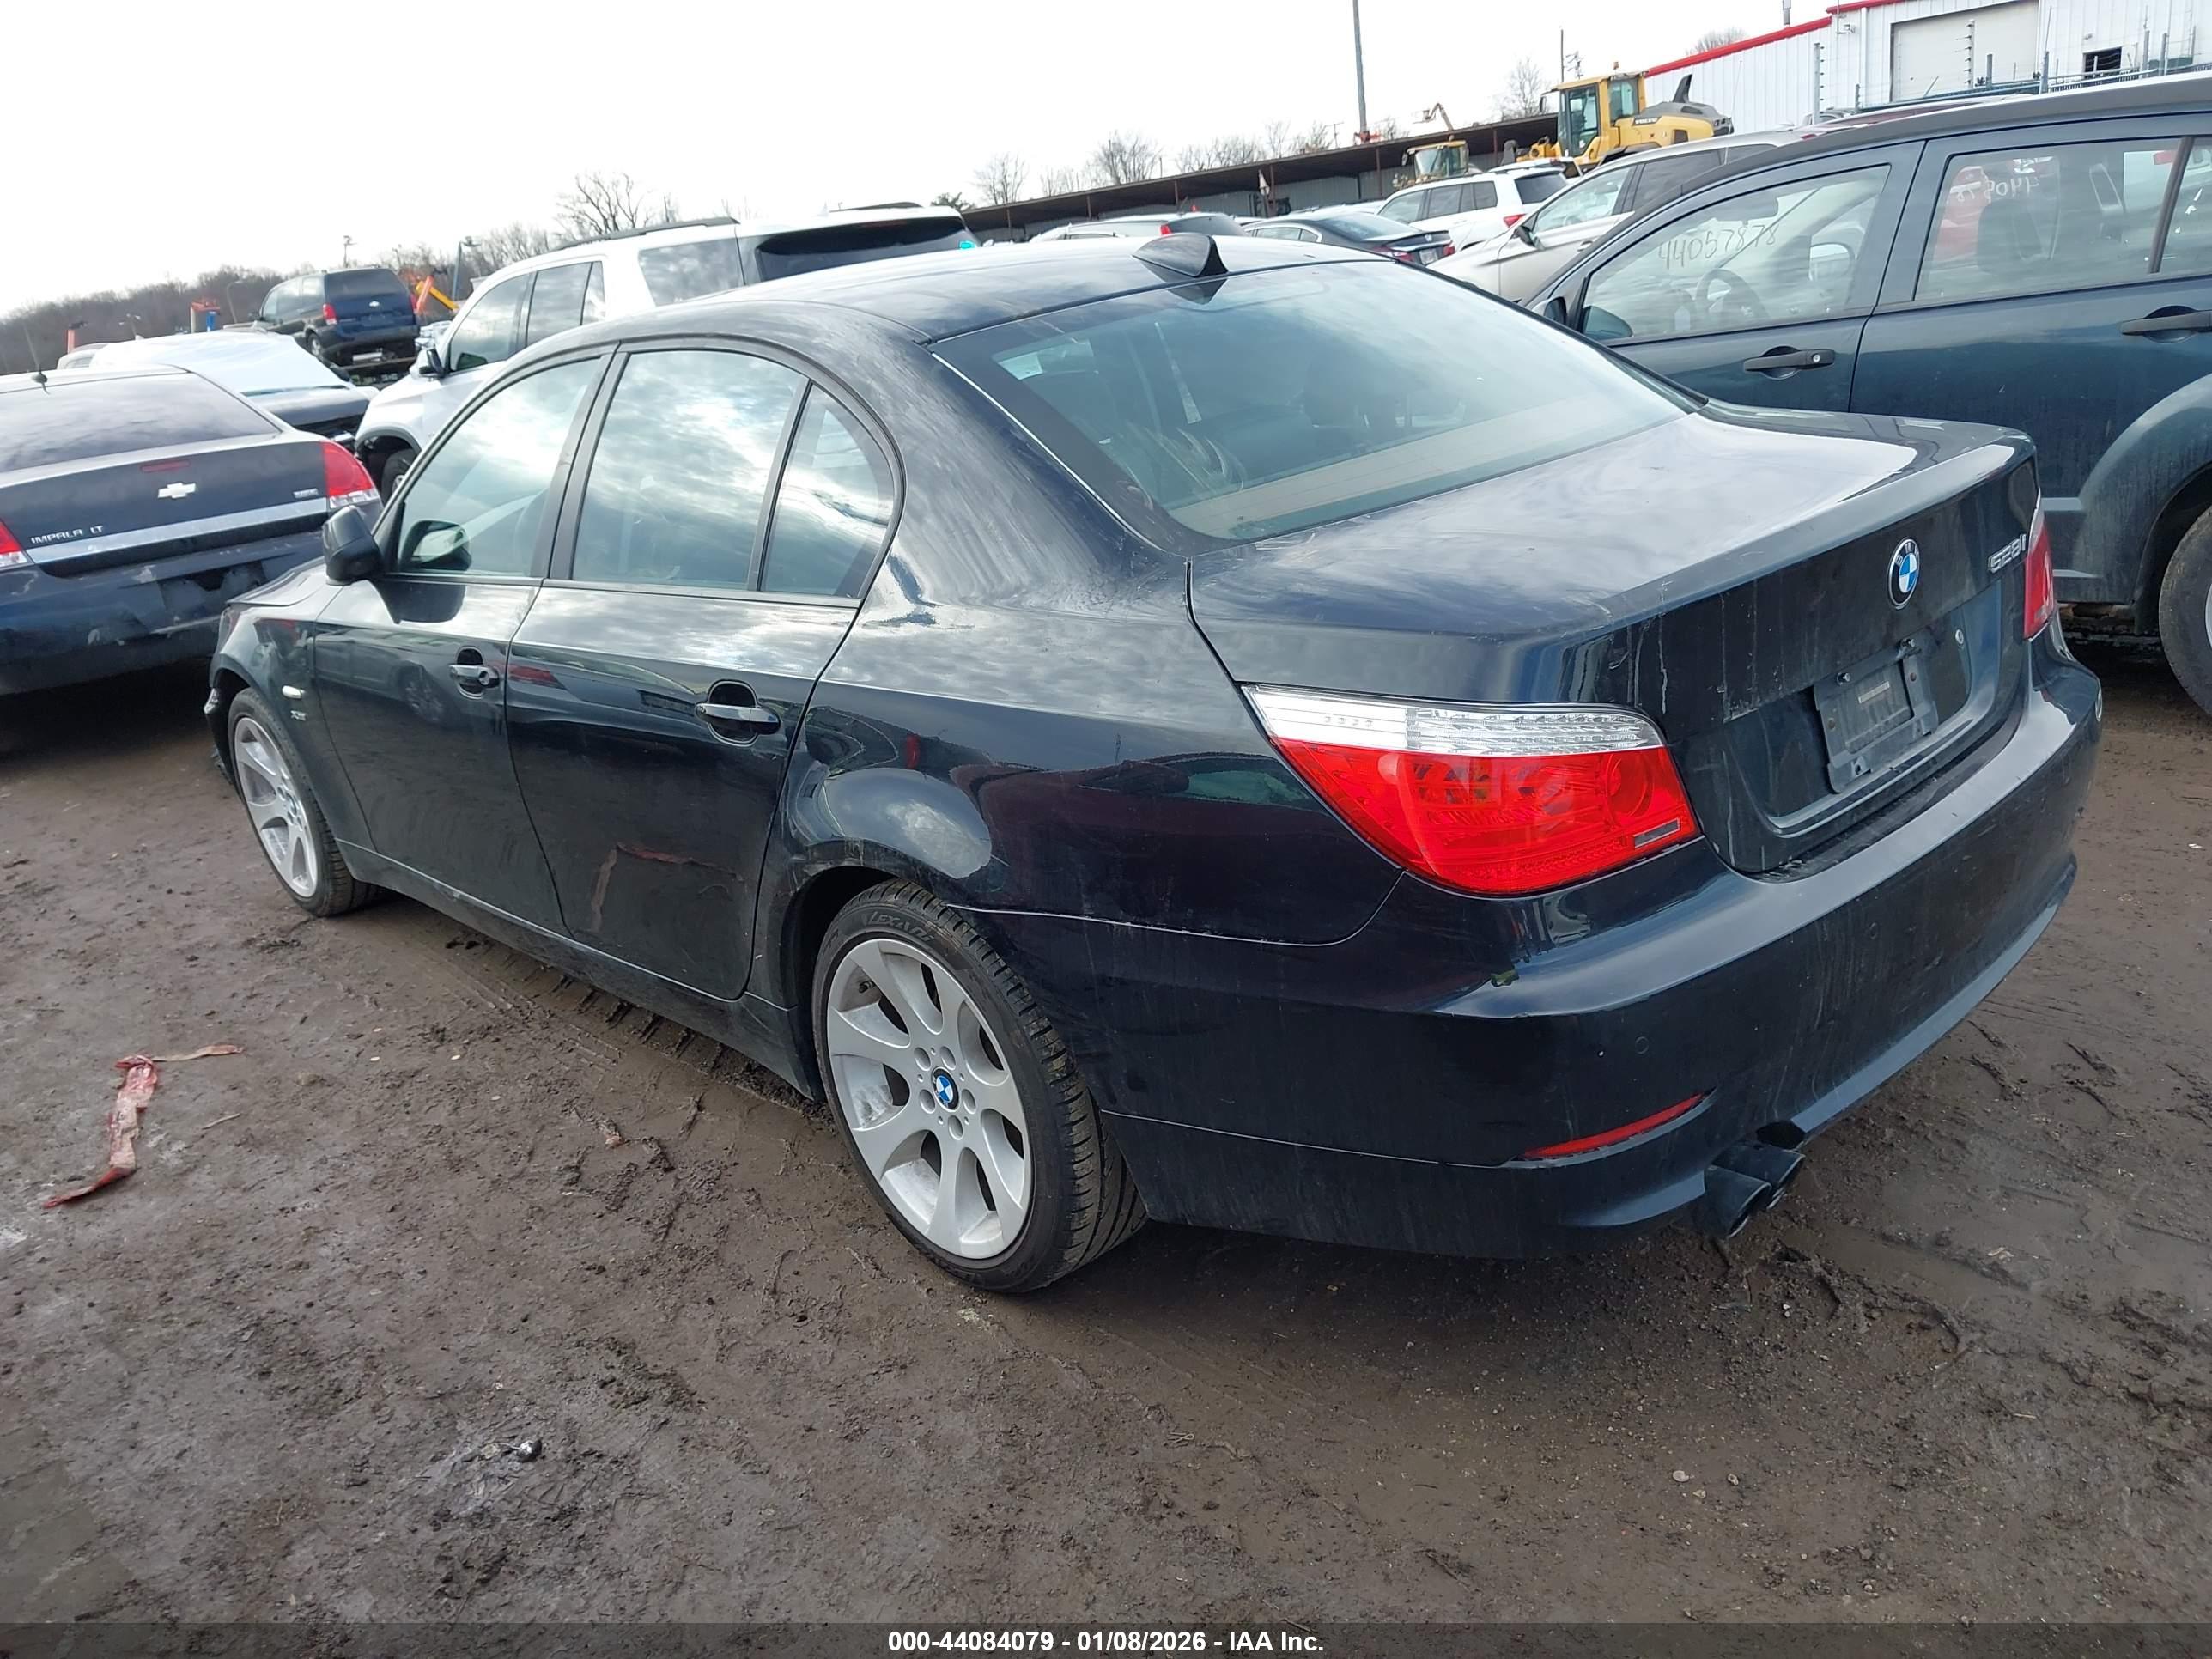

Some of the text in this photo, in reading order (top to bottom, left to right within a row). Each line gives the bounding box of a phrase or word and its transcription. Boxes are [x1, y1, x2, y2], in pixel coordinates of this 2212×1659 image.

[1658, 224, 1780, 270] 44057878
[30, 525, 104, 544] IMPALA LT
